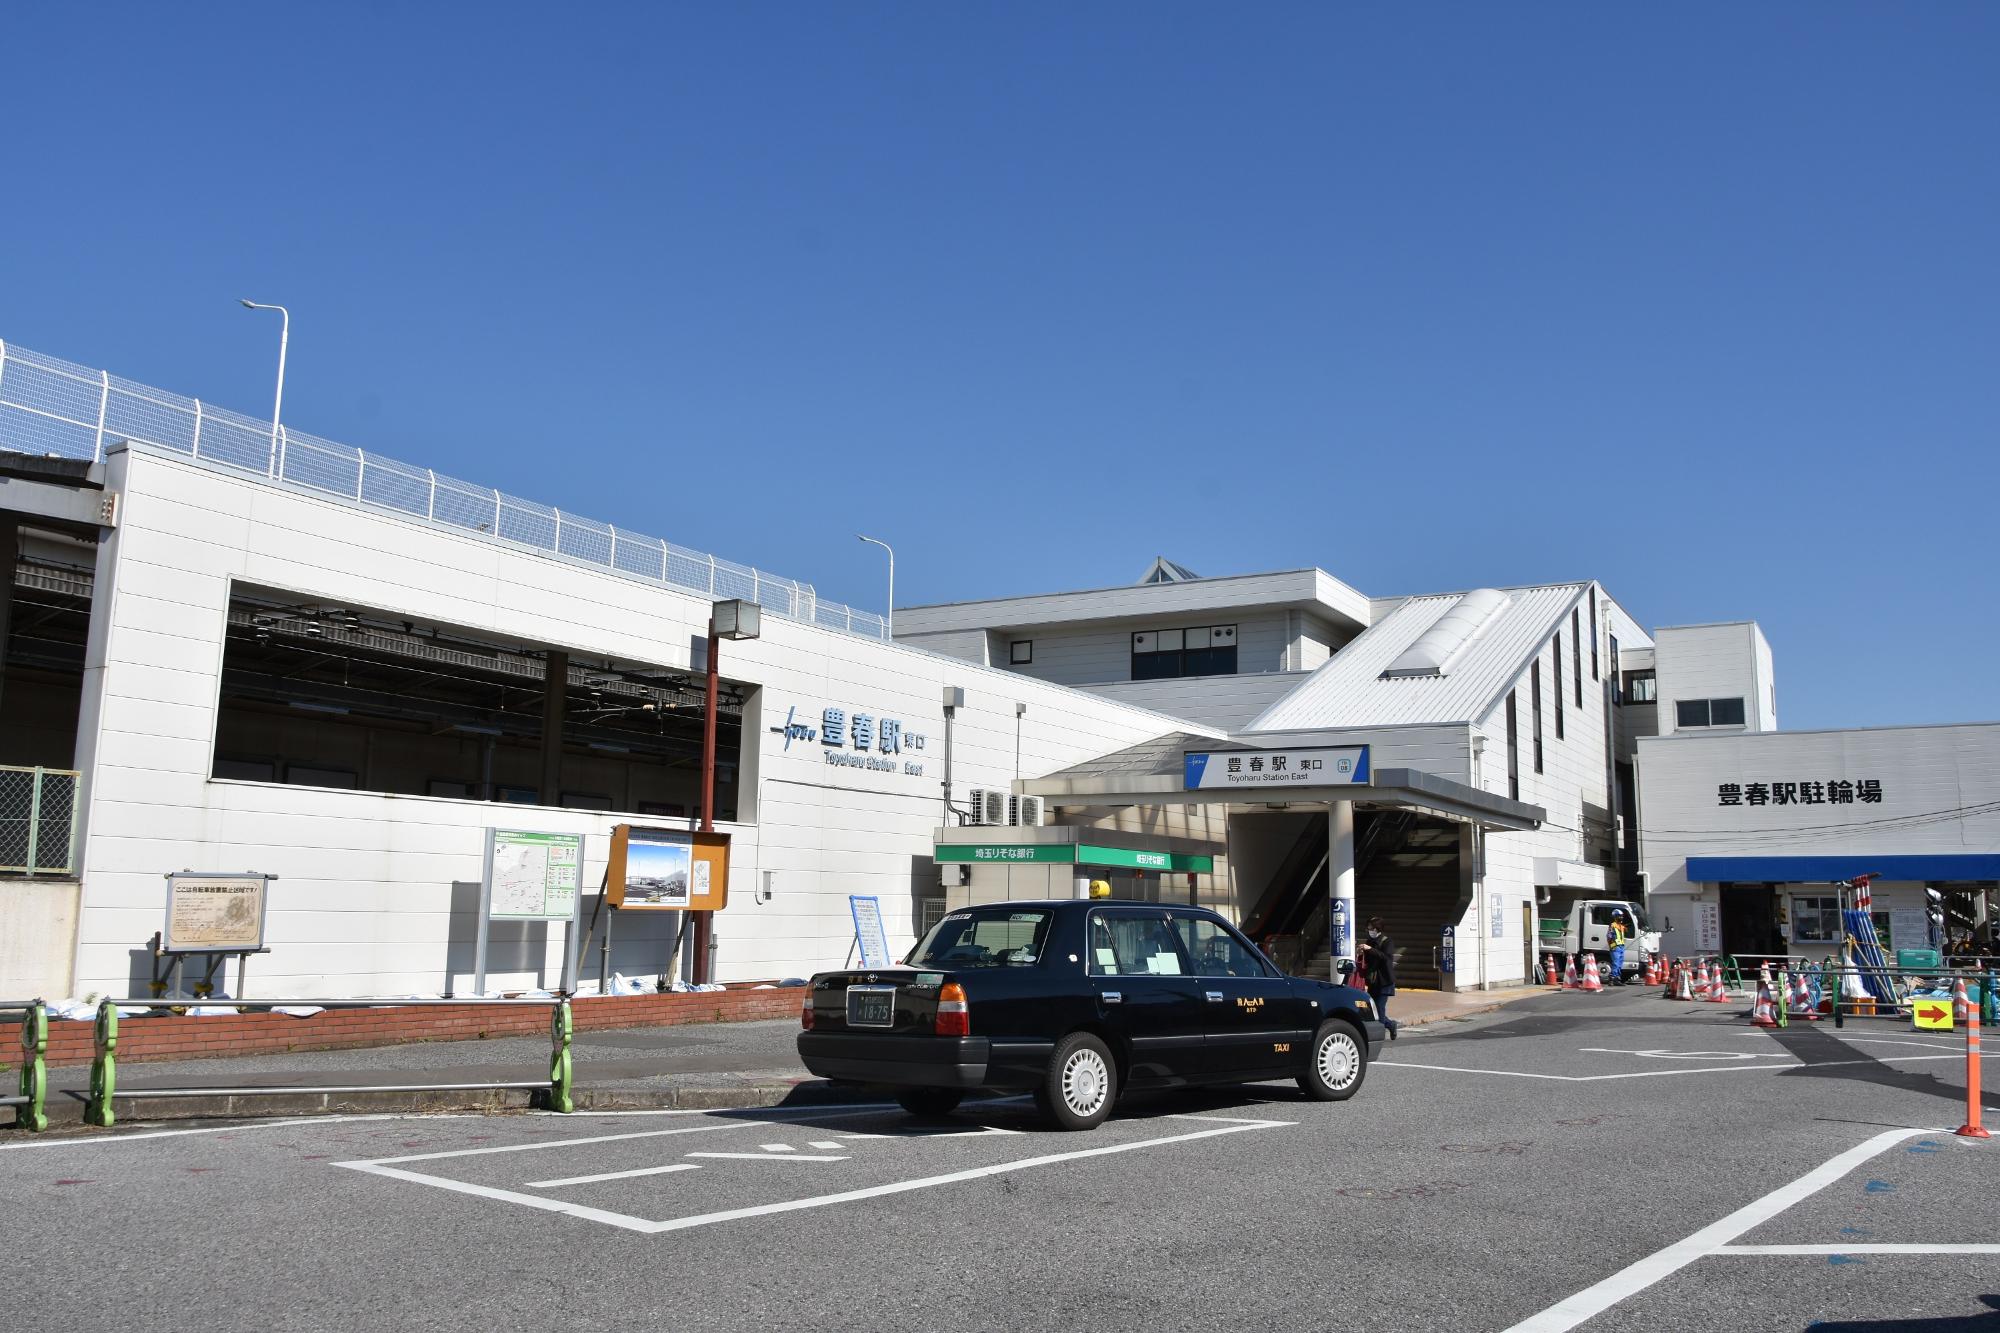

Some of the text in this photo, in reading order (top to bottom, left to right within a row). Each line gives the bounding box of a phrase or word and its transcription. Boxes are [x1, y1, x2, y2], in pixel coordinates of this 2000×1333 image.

[821, 707, 926, 755] 豊春駅 東口
[824, 750, 923, 776] Toyoharu Station East
[1227, 756, 1322, 773] 豊春駅 東口
[1227, 774, 1261, 783] Toyoharu
[1262, 774, 1289, 782] Station
[1718, 779, 1882, 806] 豊春駅駐輪場
[975, 848, 1035, 859] 埼玉りそな銀行
[1274, 1044, 1290, 1052] TAXI
